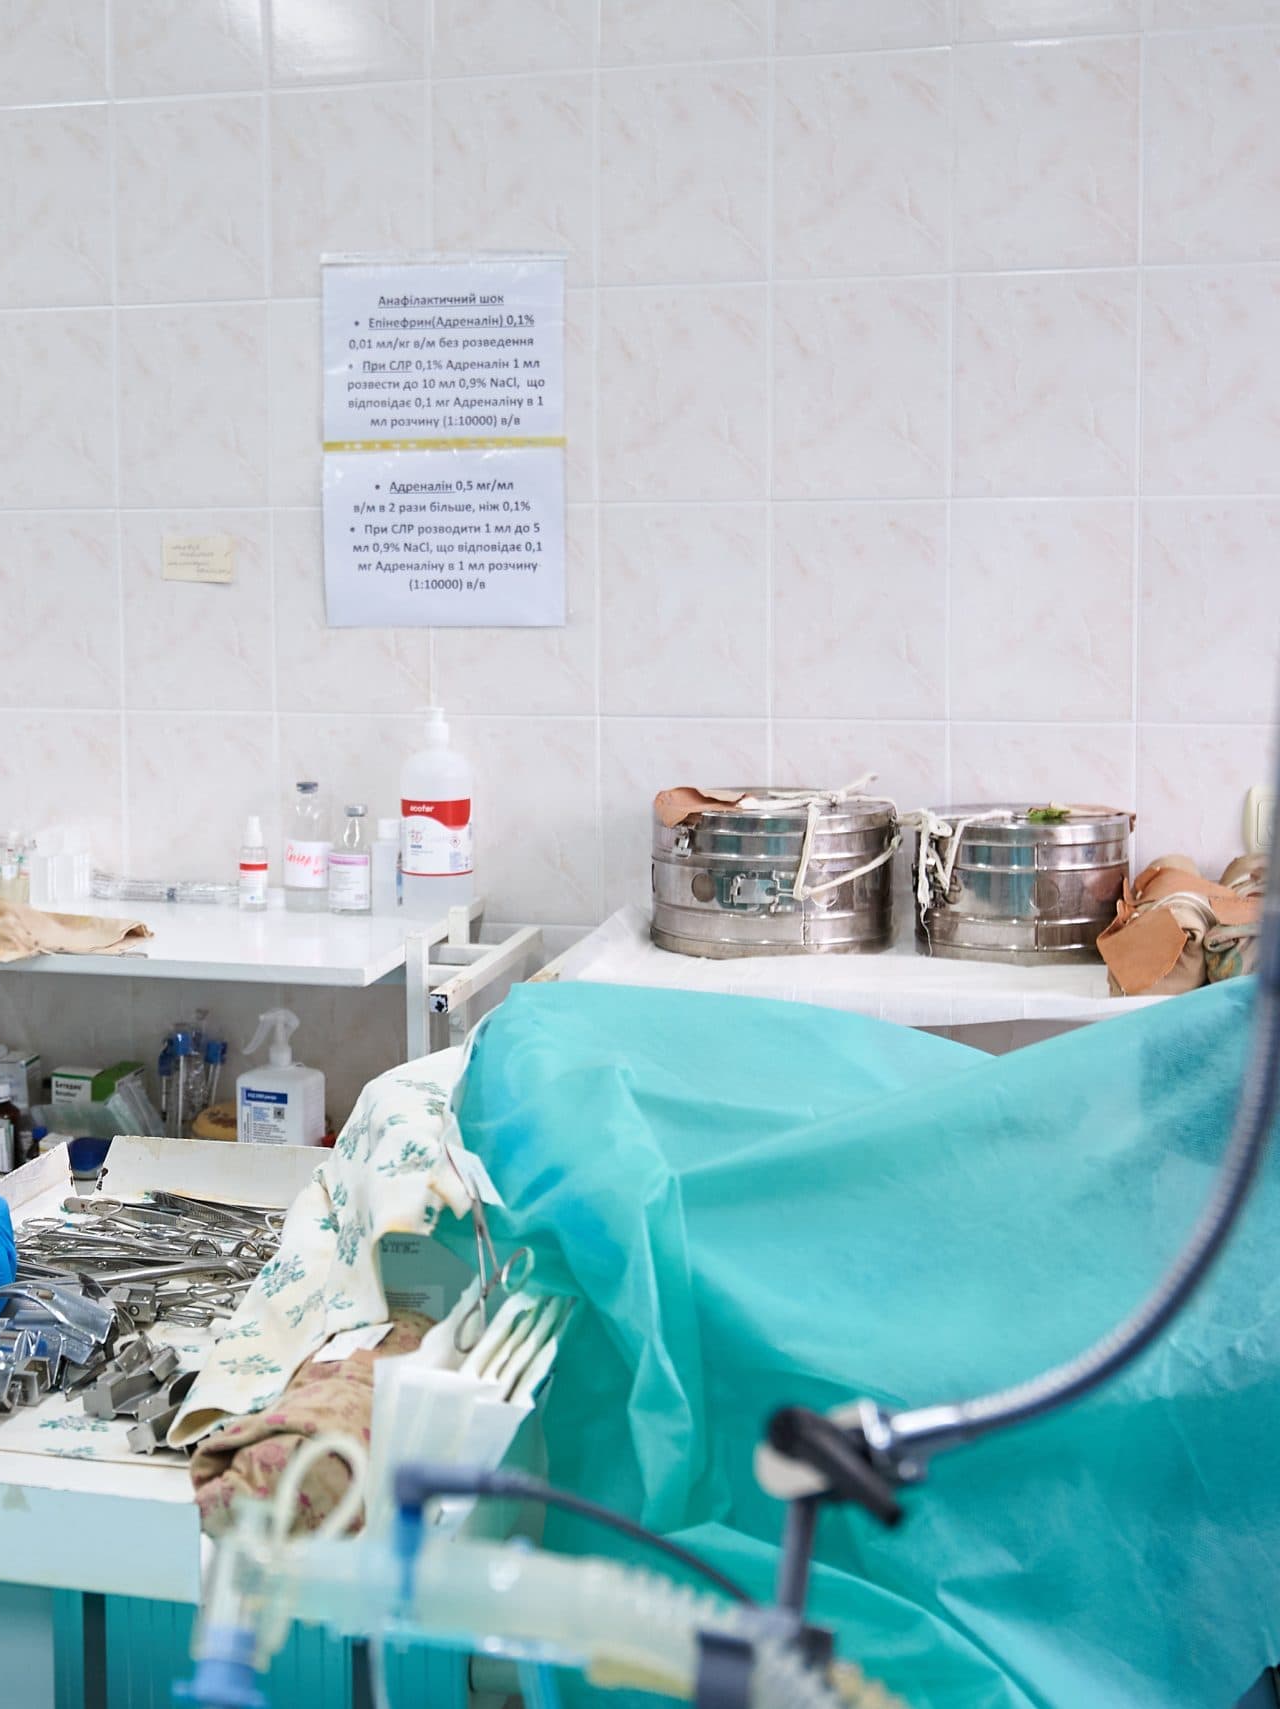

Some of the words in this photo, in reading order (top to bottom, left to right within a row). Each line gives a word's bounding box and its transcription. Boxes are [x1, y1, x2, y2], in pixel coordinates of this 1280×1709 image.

[378, 293, 476, 307] Анафілактичний
[479, 295, 504, 305] шок
[369, 315, 503, 329] Епінефрин(Адреналін)
[506, 314, 534, 327] 0,1%
[349, 339, 372, 350] 0,01
[376, 338, 410, 351] мл/кг
[413, 338, 435, 350] в/м
[439, 337, 459, 348] без
[462, 337, 533, 349] розведення
[363, 361, 386, 372] При
[389, 361, 412, 371] СЛР
[415, 360, 443, 371] 0,1%
[446, 359, 509, 372] Адреналін
[522, 360, 540, 369] мл
[347, 380, 400, 391] розвести
[403, 380, 419, 390] до
[422, 379, 435, 389] 10
[439, 379, 455, 389] мл
[459, 378, 487, 389] 0,9%
[527, 378, 545, 389] що
[348, 397, 412, 410] відповідає
[415, 397, 431, 409] 0,1
[435, 398, 449, 408] мг
[452, 397, 523, 409] Адреналіну
[370, 417, 387, 427] мл
[390, 416, 439, 429] розчину
[443, 415, 498, 428] (1:10000)
[501, 414, 521, 427] в/в
[389, 481, 452, 493] Адреналін
[455, 481, 473, 492] 0,5
[476, 479, 514, 492] мг/мл
[353, 502, 376, 515] в/м
[389, 503, 396, 513] 2
[399, 504, 426, 514] рази
[430, 501, 476, 514] більше,
[479, 501, 500, 512] ніж
[503, 501, 531, 513] 0,1%
[364, 525, 388, 536] При
[391, 524, 414, 534] СЛР
[417, 524, 481, 535] розводити
[494, 525, 512, 533] мл
[514, 524, 530, 535] до
[352, 544, 369, 553] мл
[372, 543, 400, 554] 0,9%
[436, 543, 454, 554] що
[458, 542, 522, 554] відповідає
[524, 542, 542, 553] 0,1
[358, 562, 373, 572] мг
[375, 561, 445, 573] Адреналіну
[468, 562, 485, 571] мл
[488, 561, 538, 572] розчину
[409, 579, 463, 591] (1:10000)
[466, 578, 486, 590] в/в
